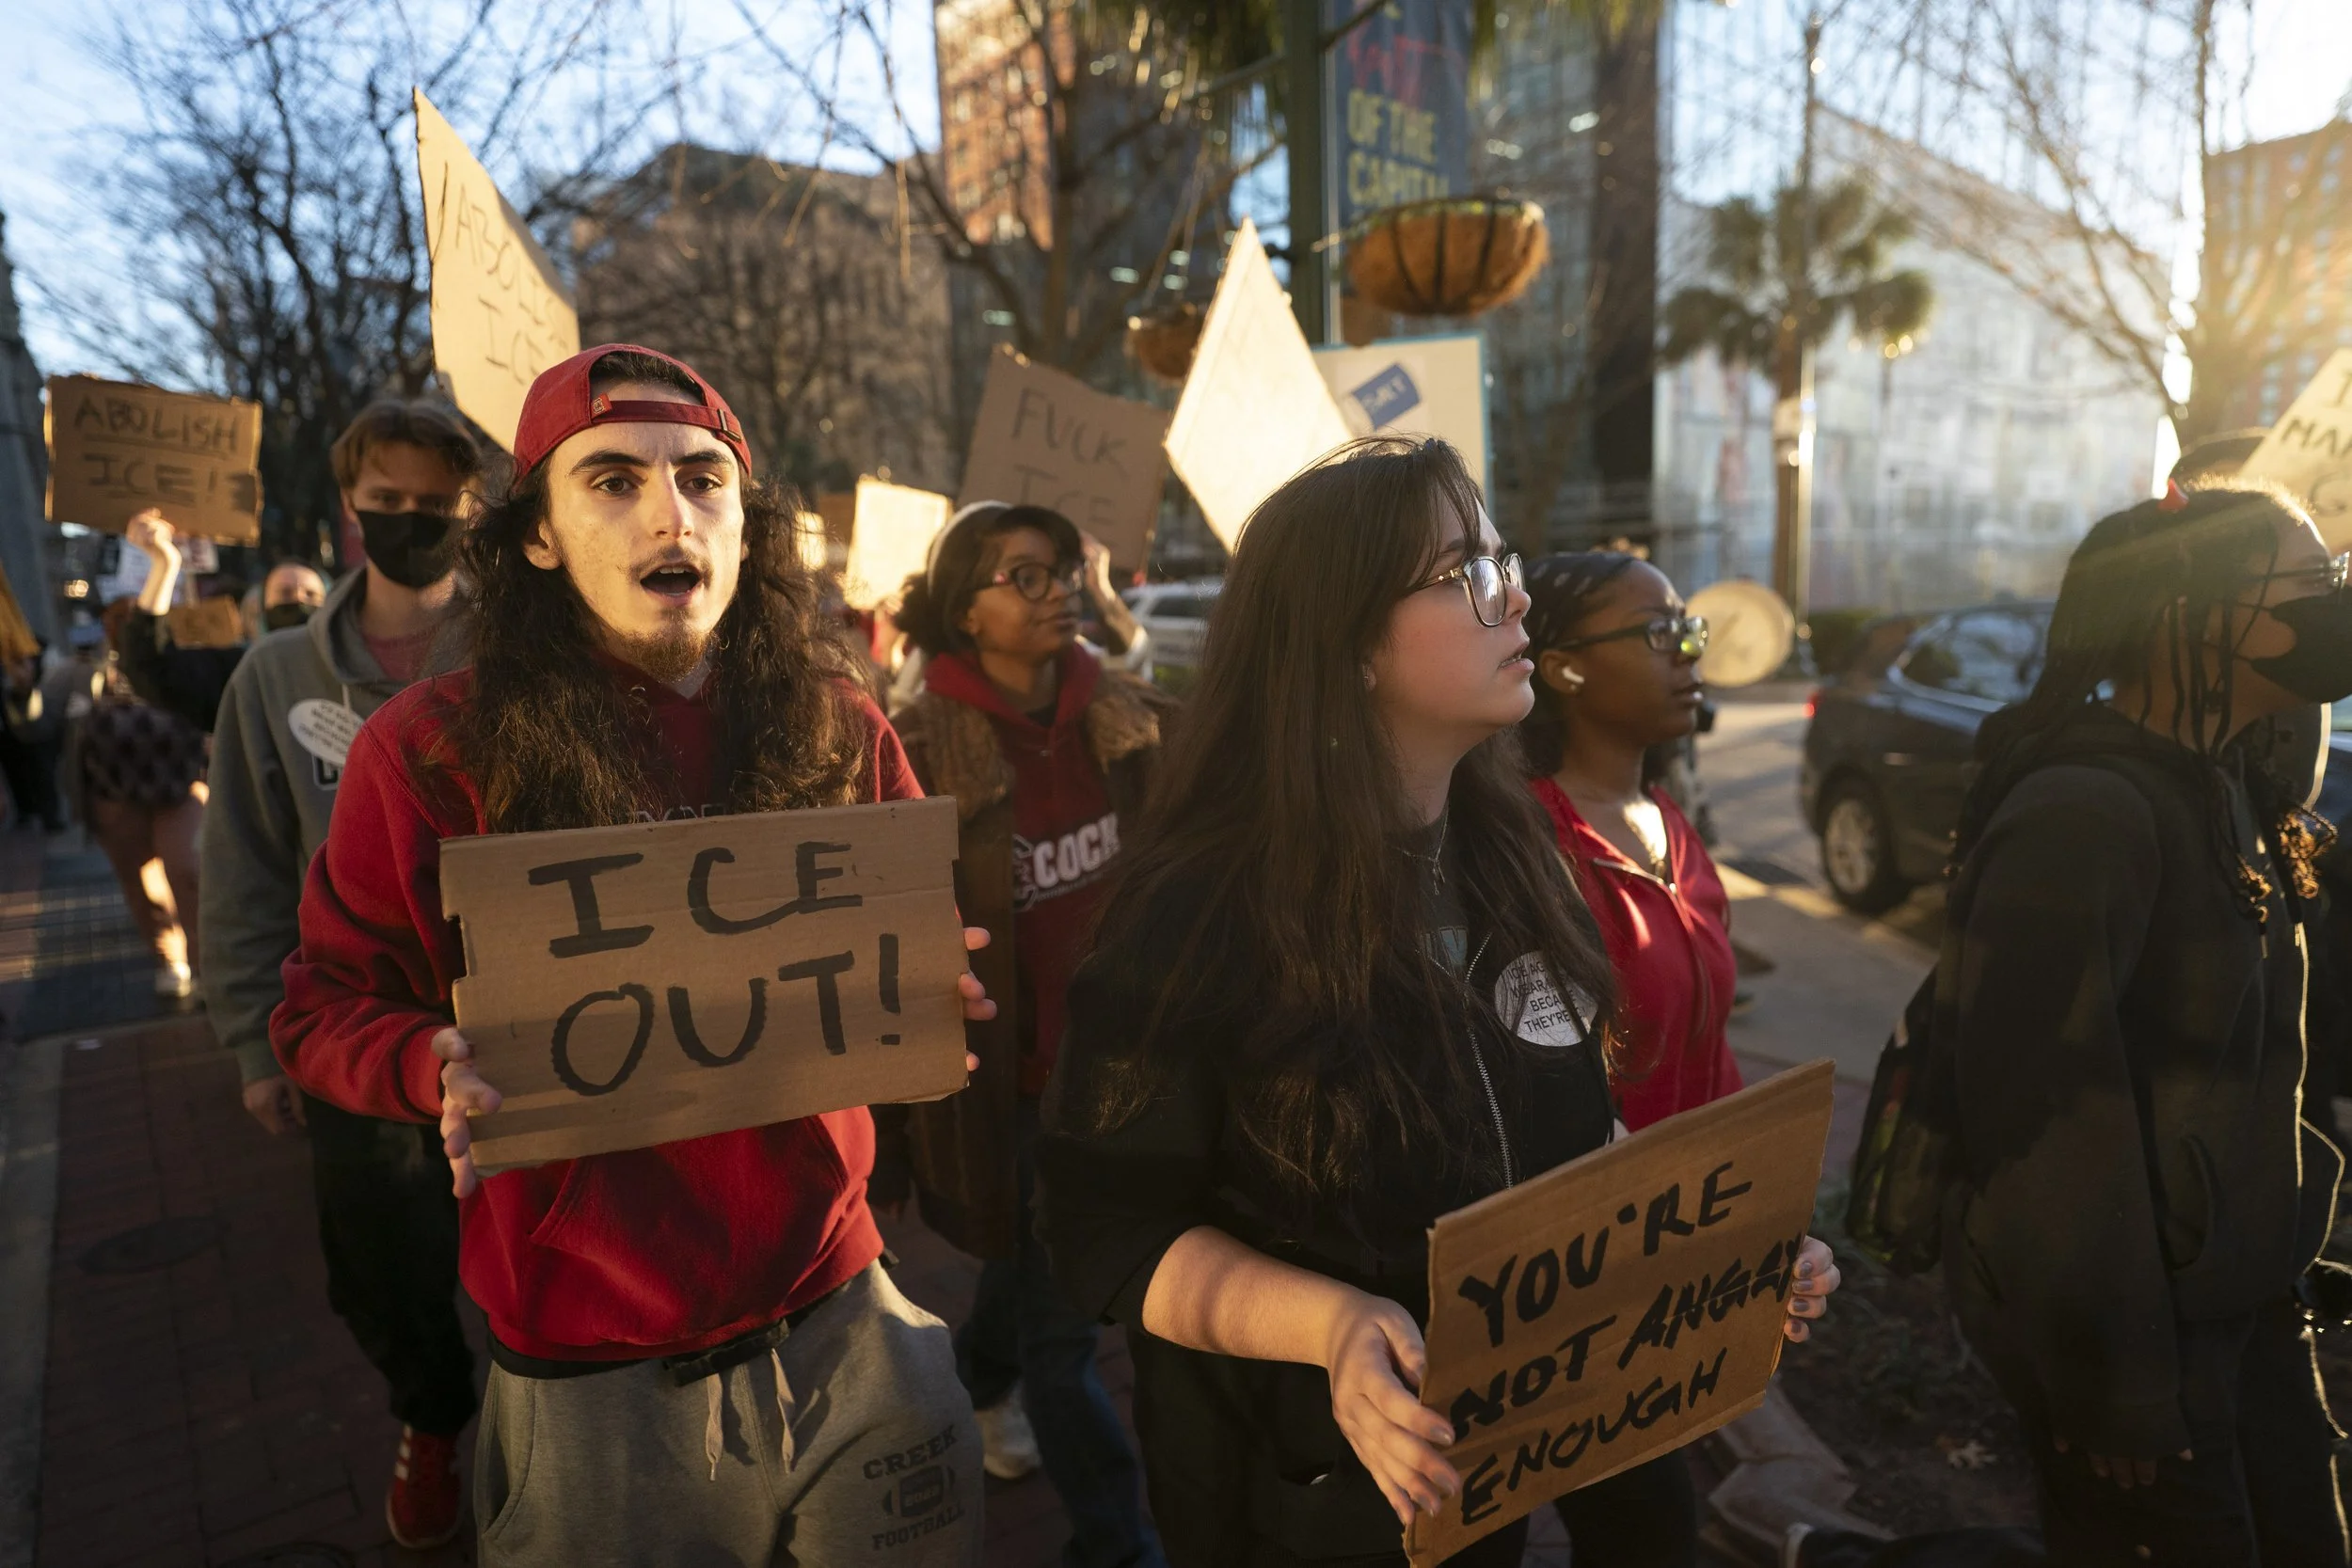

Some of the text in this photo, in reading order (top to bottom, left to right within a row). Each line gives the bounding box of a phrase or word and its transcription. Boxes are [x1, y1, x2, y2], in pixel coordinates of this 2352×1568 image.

[74, 391, 238, 451] ABOLISH
[1011, 387, 1130, 482] FUCK
[528, 841, 864, 958] ICE
[550, 933, 902, 1096] OUT!
[1524, 1009, 1571, 1033] THEY'RE
[1458, 1161, 1753, 1347] YOU'RE
[1452, 1315, 1617, 1443] NOT
[1461, 1347, 1727, 1526] ENOUGH
[863, 1424, 958, 1481] CREEK
